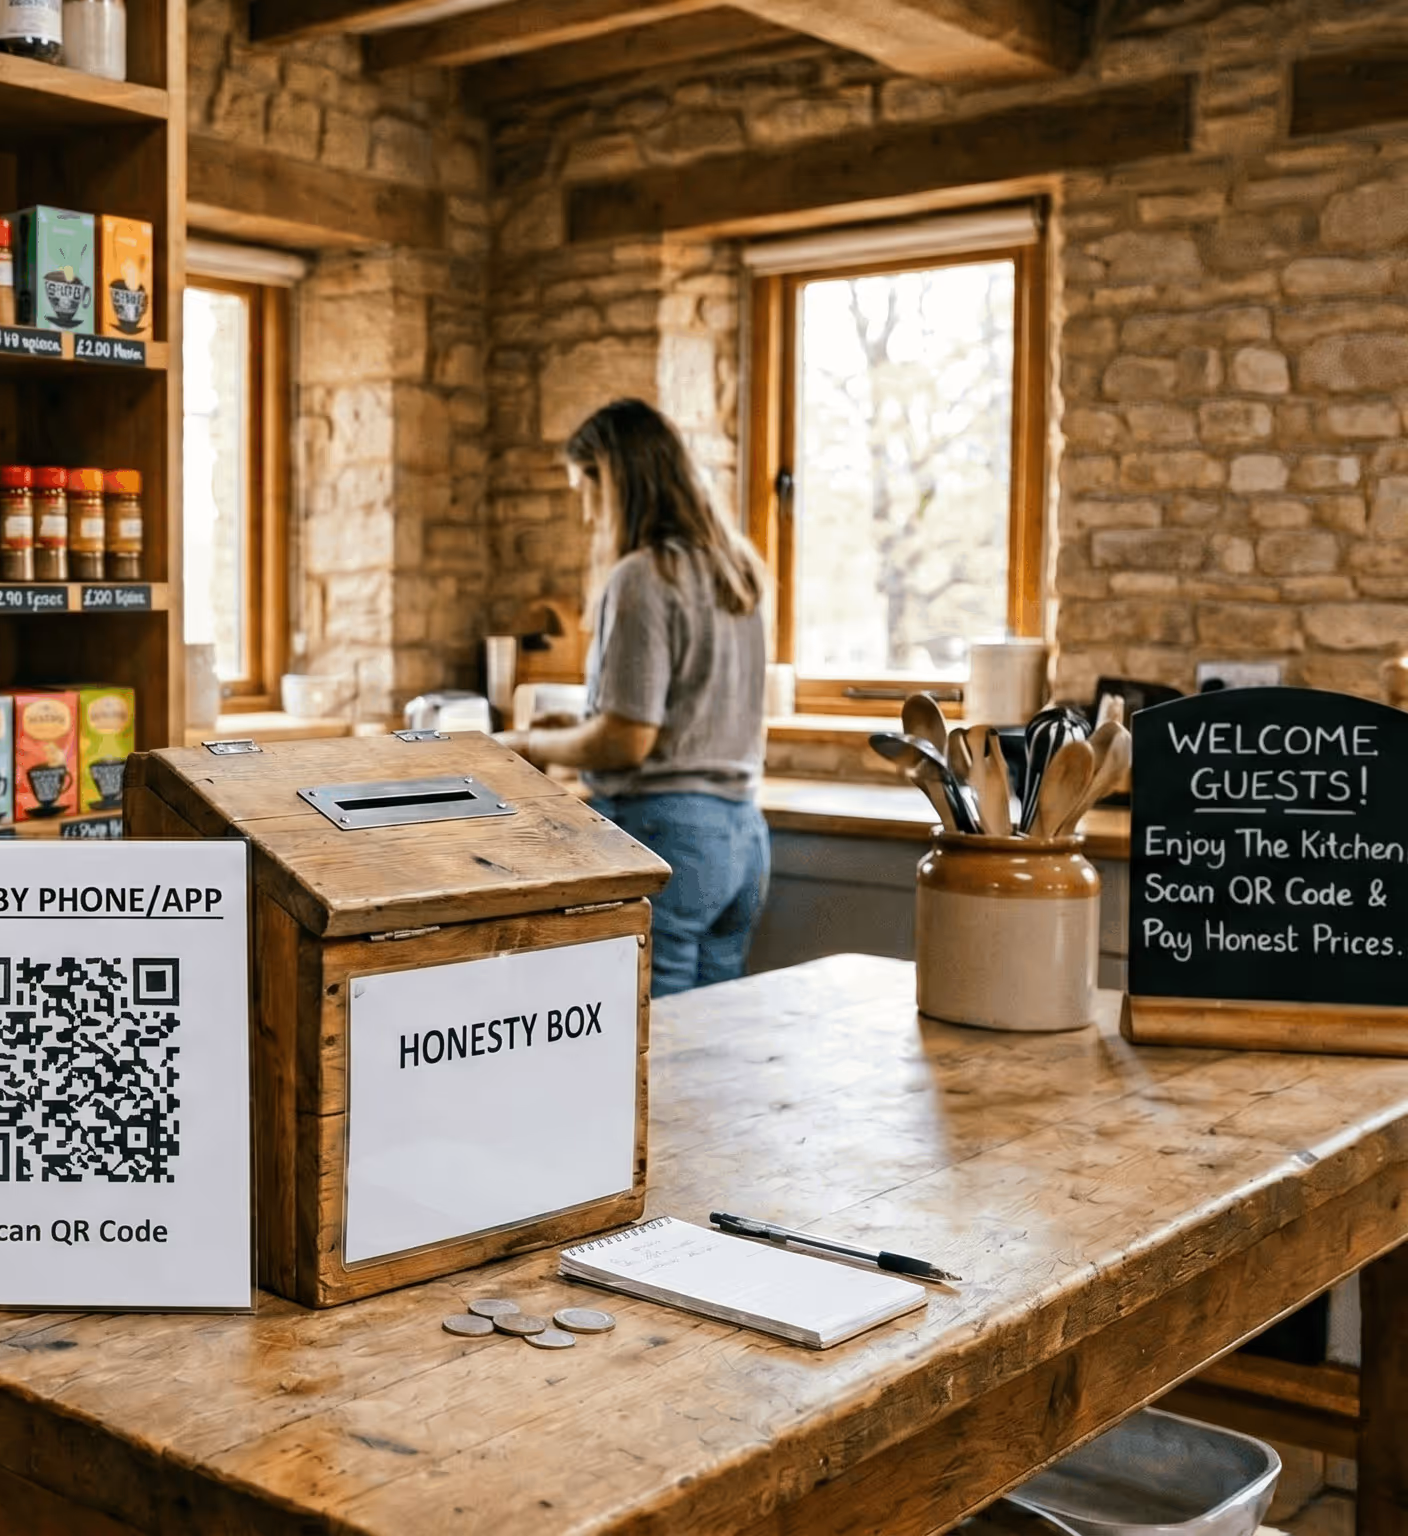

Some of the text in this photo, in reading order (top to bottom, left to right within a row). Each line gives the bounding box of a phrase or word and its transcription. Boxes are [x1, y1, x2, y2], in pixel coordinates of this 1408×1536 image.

[1168, 721, 1379, 756] WELCOME
[1190, 765, 1368, 806] GUESTS!
[1145, 825, 1226, 869] Enjoy
[1234, 828, 1291, 858] The
[39, 884, 223, 918] PHONE/APP
[1144, 873, 1387, 907] Scan QR Code &
[1142, 917, 1403, 962] Pay Honest Prices.
[399, 1002, 603, 1070] HONESTY BOX
[49, 1218, 92, 1246] QR
[99, 1218, 170, 1244] Code
